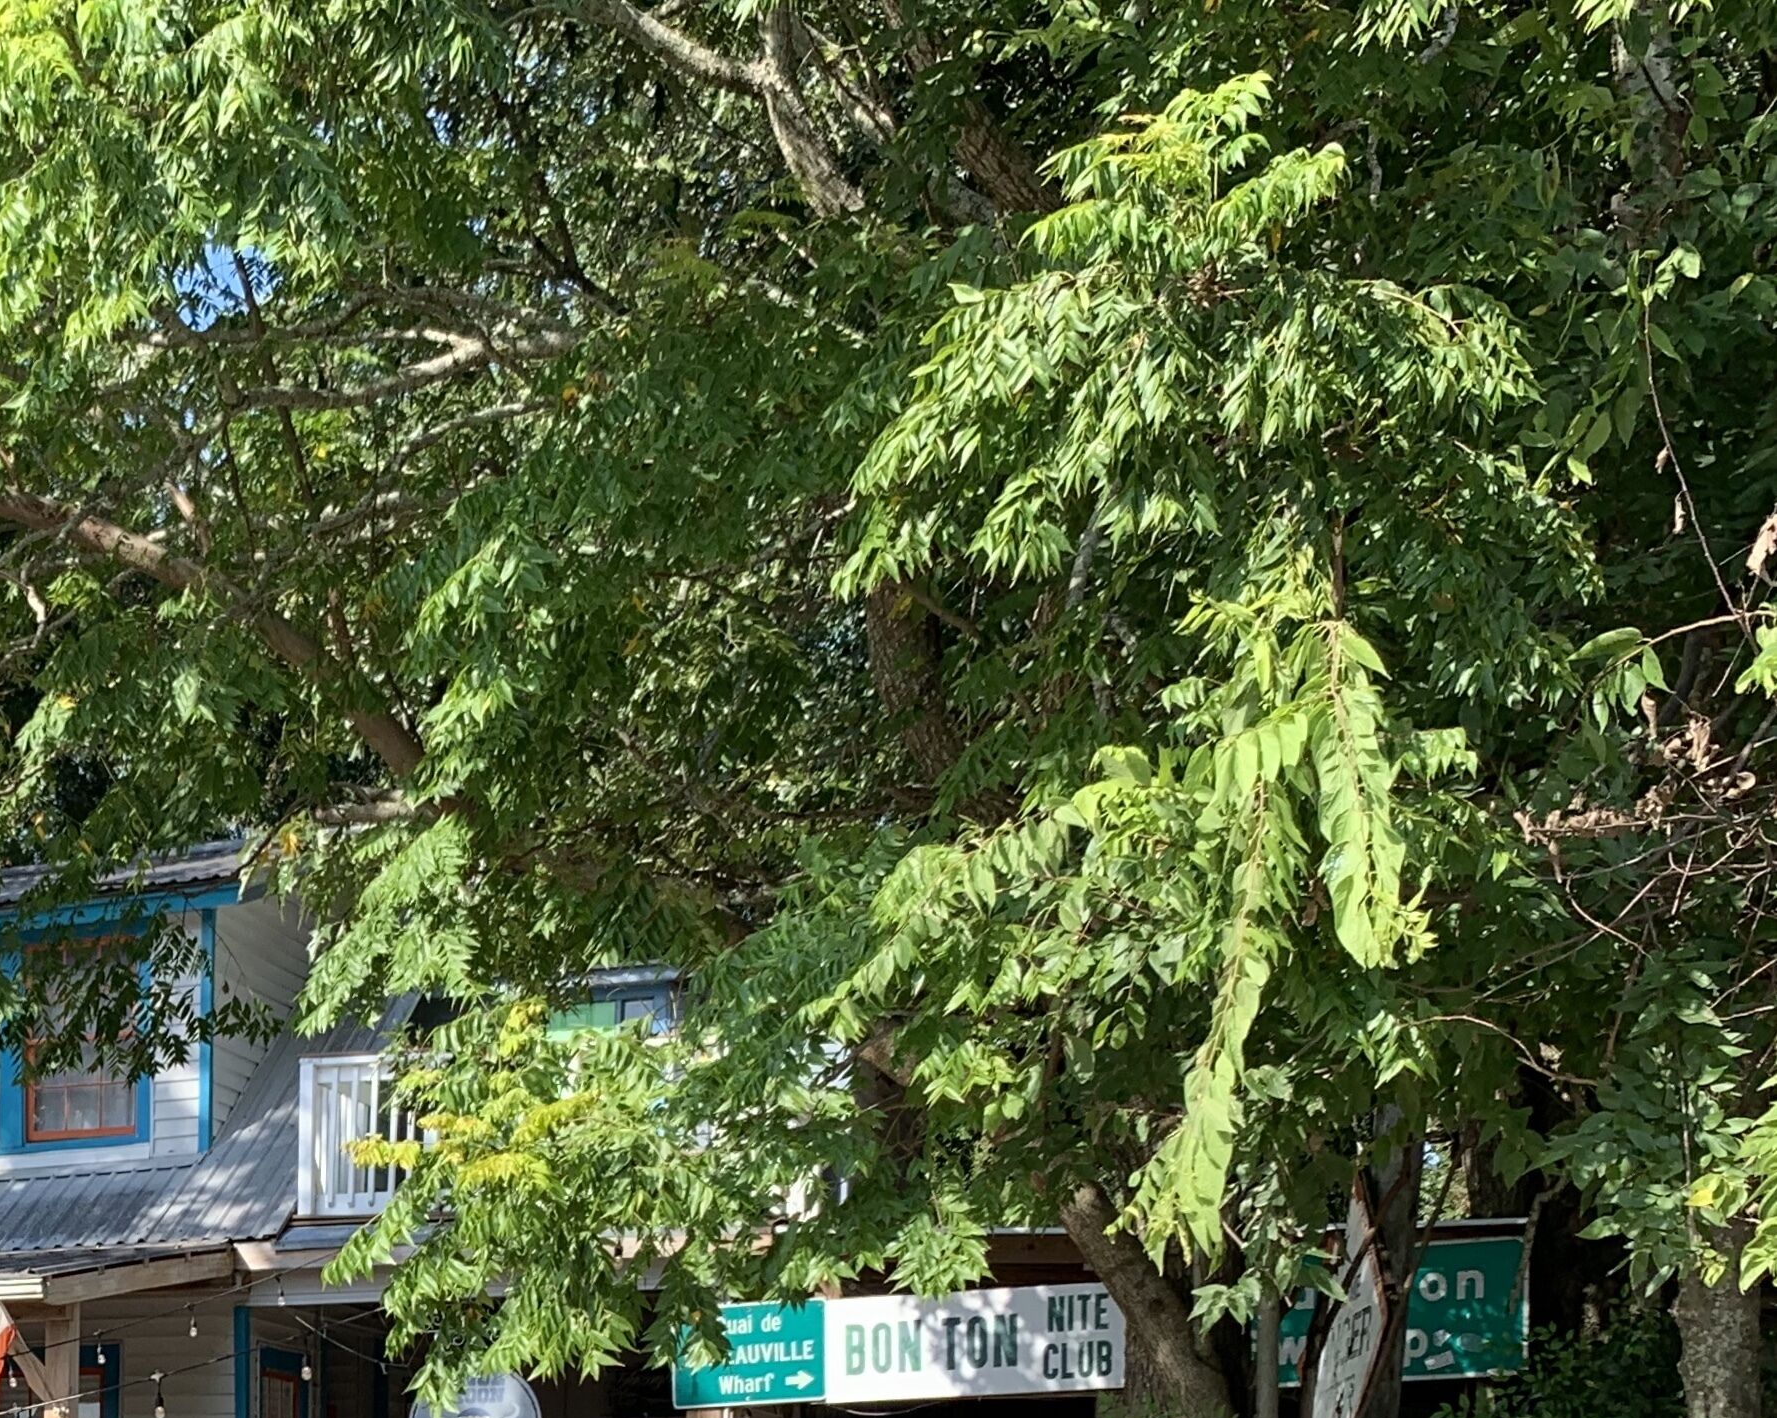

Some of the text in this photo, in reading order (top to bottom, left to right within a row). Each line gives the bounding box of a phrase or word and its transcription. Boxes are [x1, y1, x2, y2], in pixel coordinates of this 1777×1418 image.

[760, 1312, 782, 1333] de
[1047, 1292, 1109, 1333] NITE
[844, 1312, 1018, 1377] BON TON
[1042, 1339, 1113, 1380] CLUB
[458, 1387, 506, 1404] OON
[718, 1372, 775, 1396] Wharf
